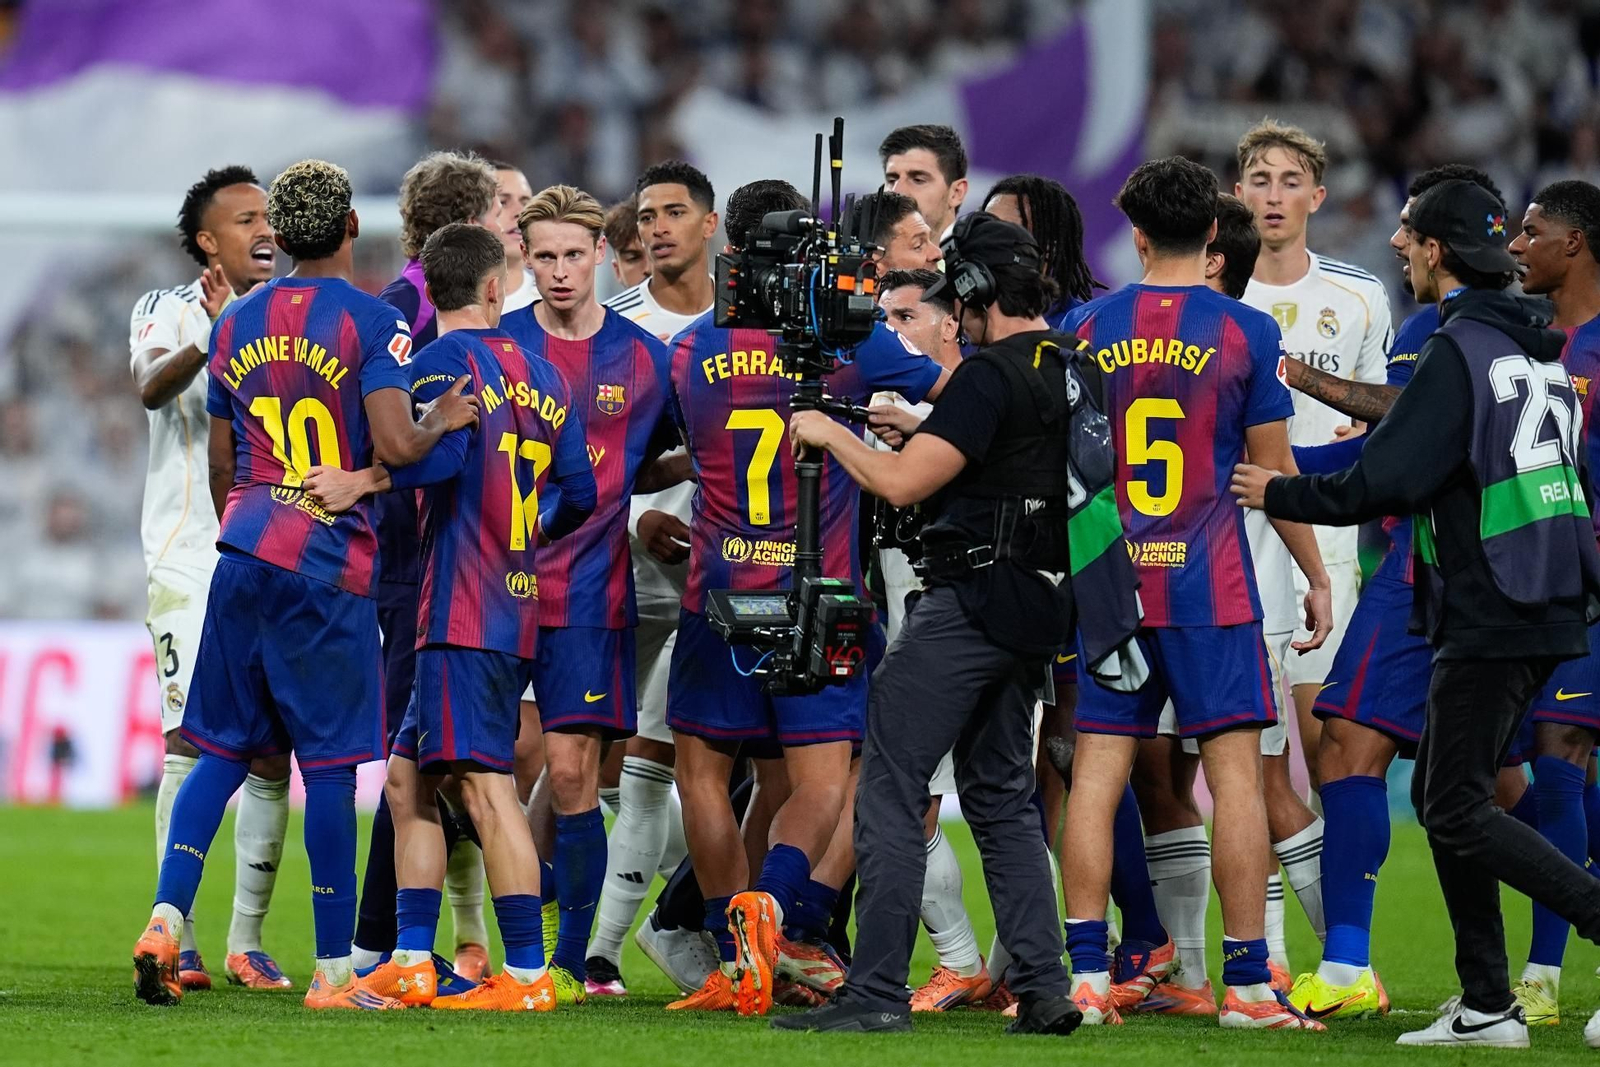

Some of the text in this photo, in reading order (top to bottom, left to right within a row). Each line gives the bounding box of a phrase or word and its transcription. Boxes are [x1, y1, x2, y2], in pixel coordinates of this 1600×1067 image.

[223, 336, 349, 390] LAMINE YAMAL
[1097, 338, 1217, 376] CUBARSÍ
[481, 384, 504, 415] M.
[249, 396, 342, 488] 10
[1125, 397, 1186, 517] 5
[725, 409, 785, 525] 7
[497, 431, 552, 551] 17
[1540, 481, 1571, 504] REA
[1140, 552, 1186, 563] ACNUR
[1142, 542, 1187, 553] UNHCR
[159, 631, 180, 678] 3
